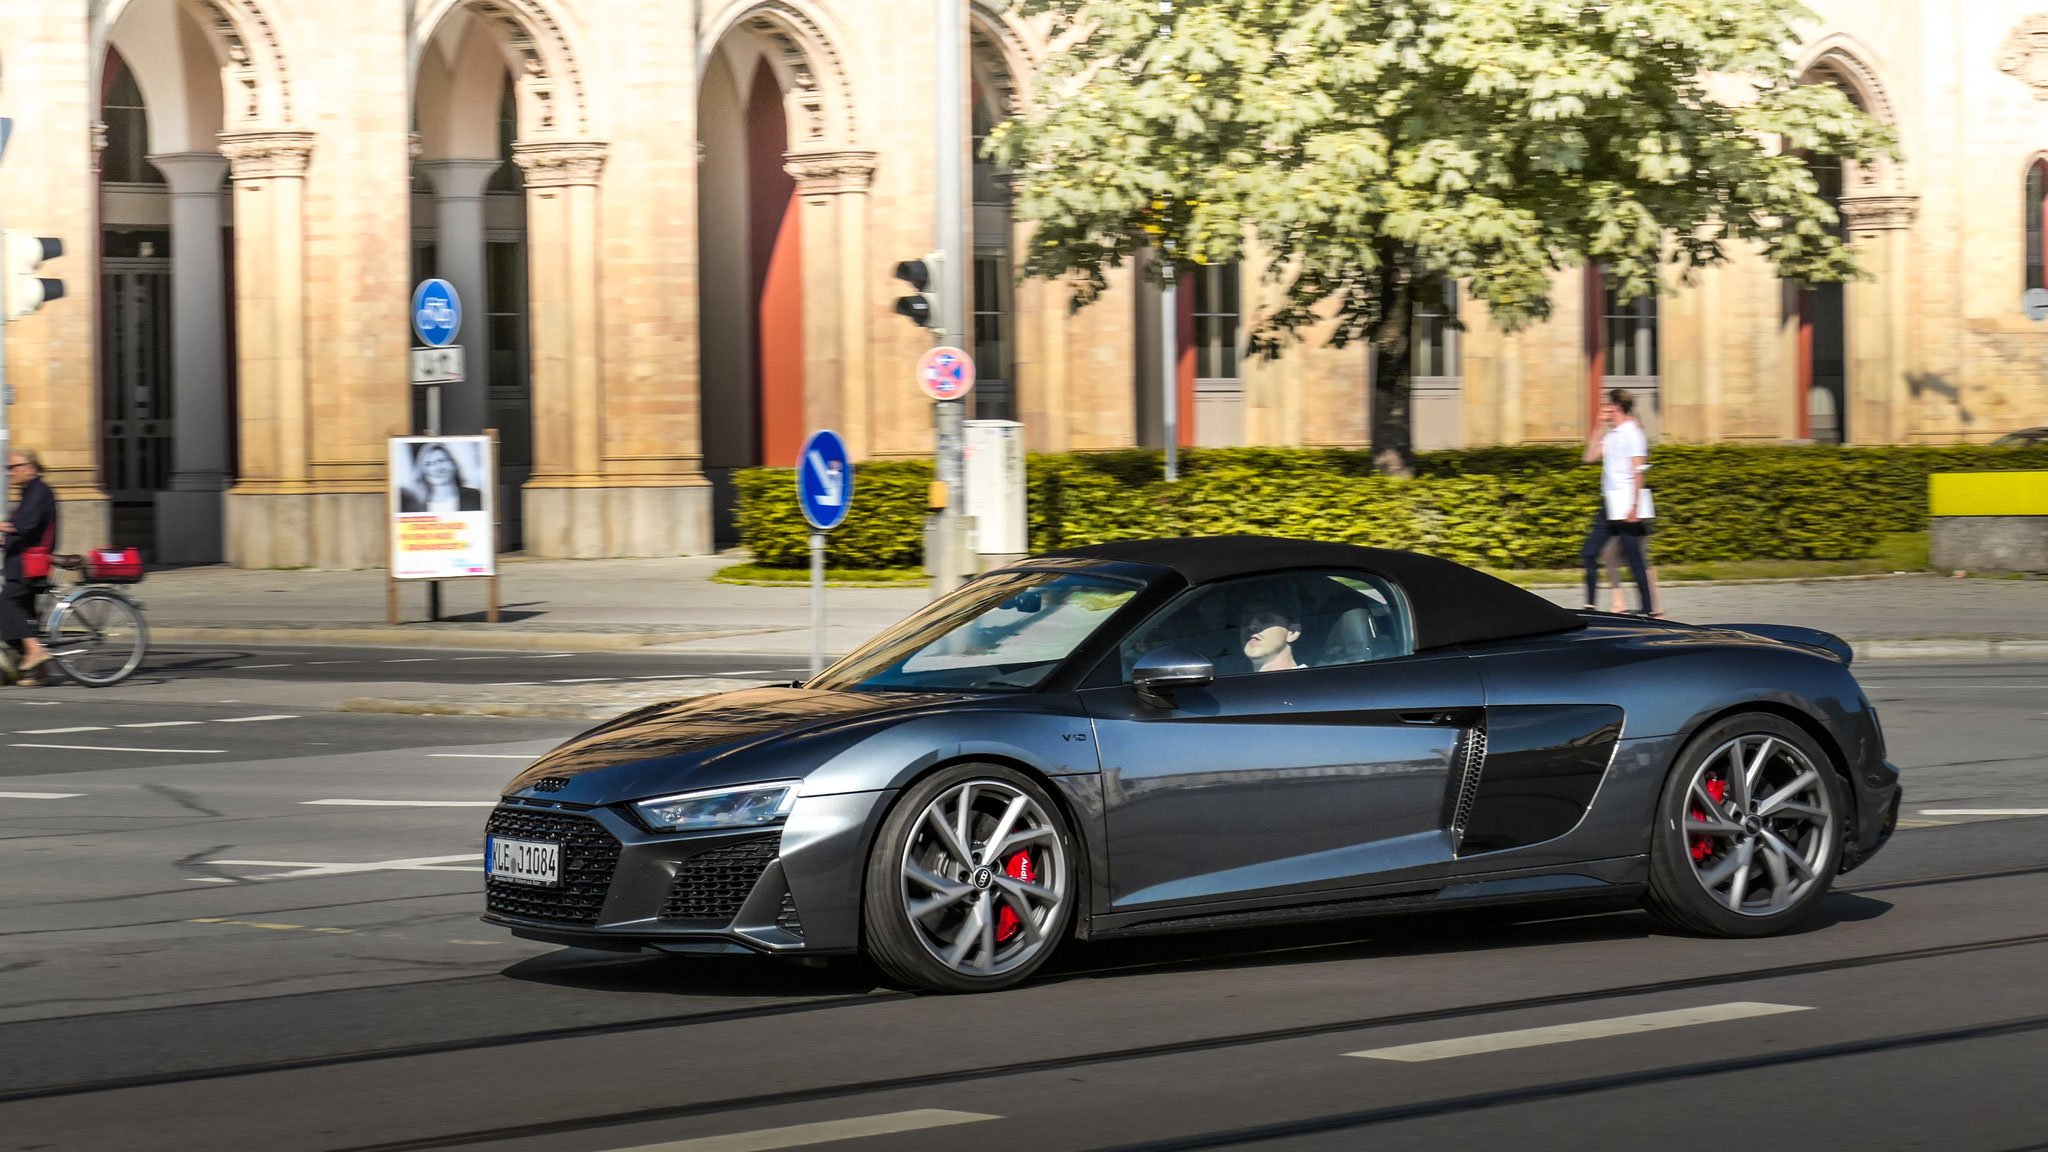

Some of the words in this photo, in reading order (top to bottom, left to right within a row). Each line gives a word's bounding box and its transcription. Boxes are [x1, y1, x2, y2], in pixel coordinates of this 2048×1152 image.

[1062, 733, 1086, 742] V10
[493, 842, 509, 871] KLE
[518, 845, 556, 876] J1084
[1020, 857, 1028, 880] Audi
